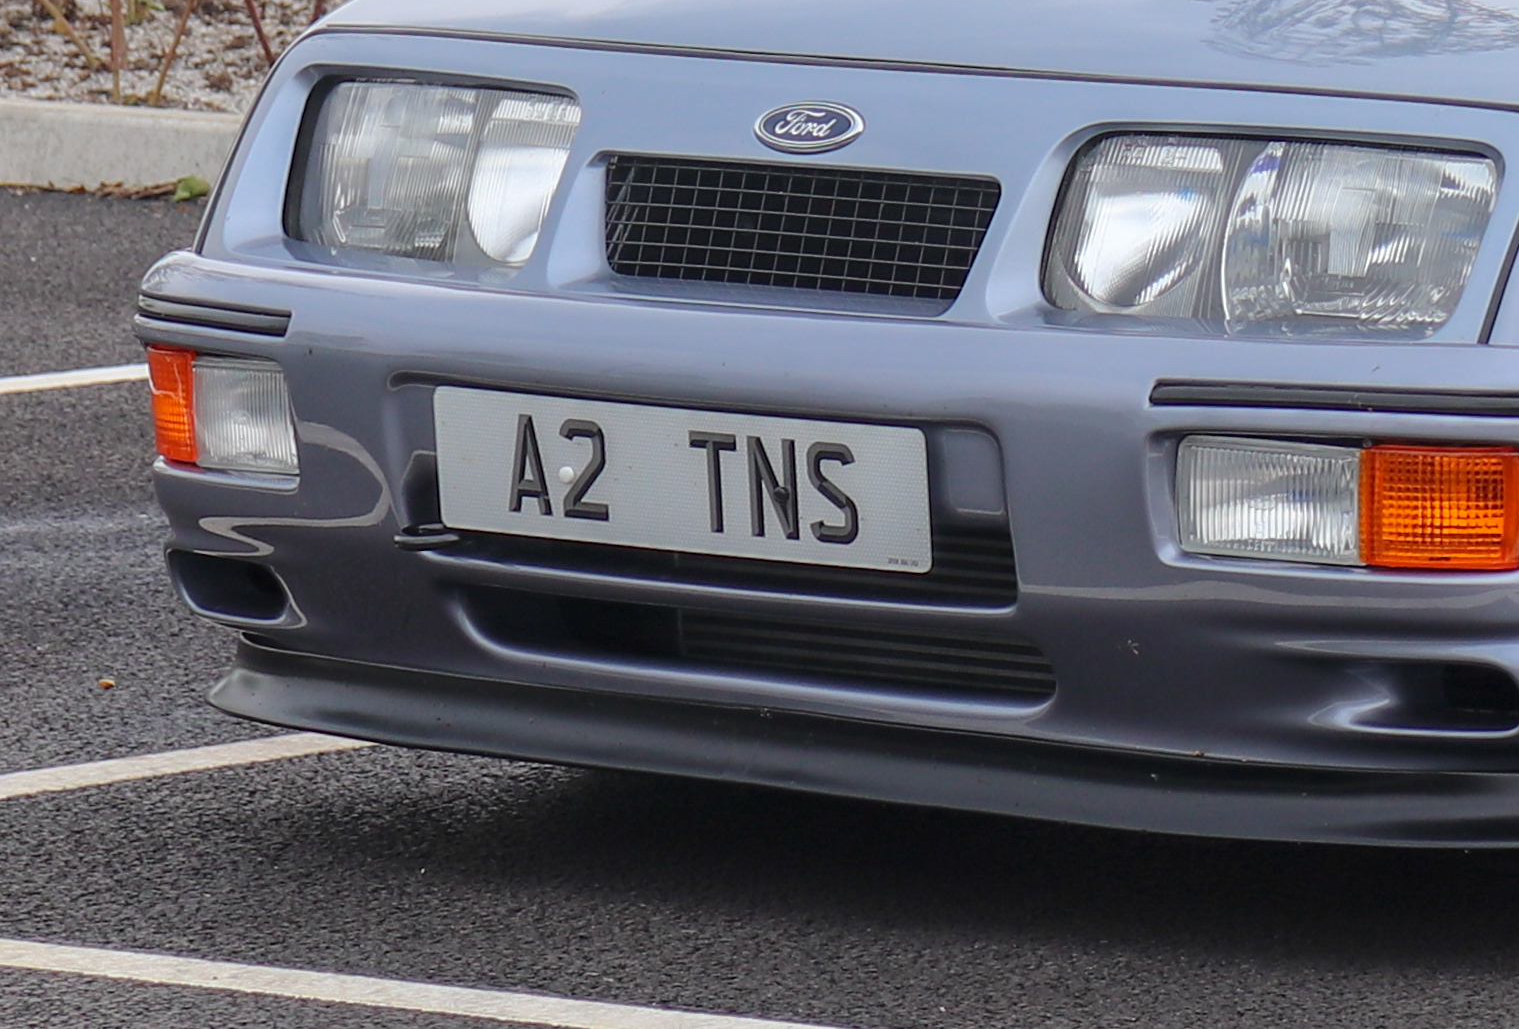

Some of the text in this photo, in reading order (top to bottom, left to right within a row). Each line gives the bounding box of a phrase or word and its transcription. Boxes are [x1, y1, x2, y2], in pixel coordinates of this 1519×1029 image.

[775, 109, 838, 137] Ford
[508, 413, 859, 545] A2 TNS
